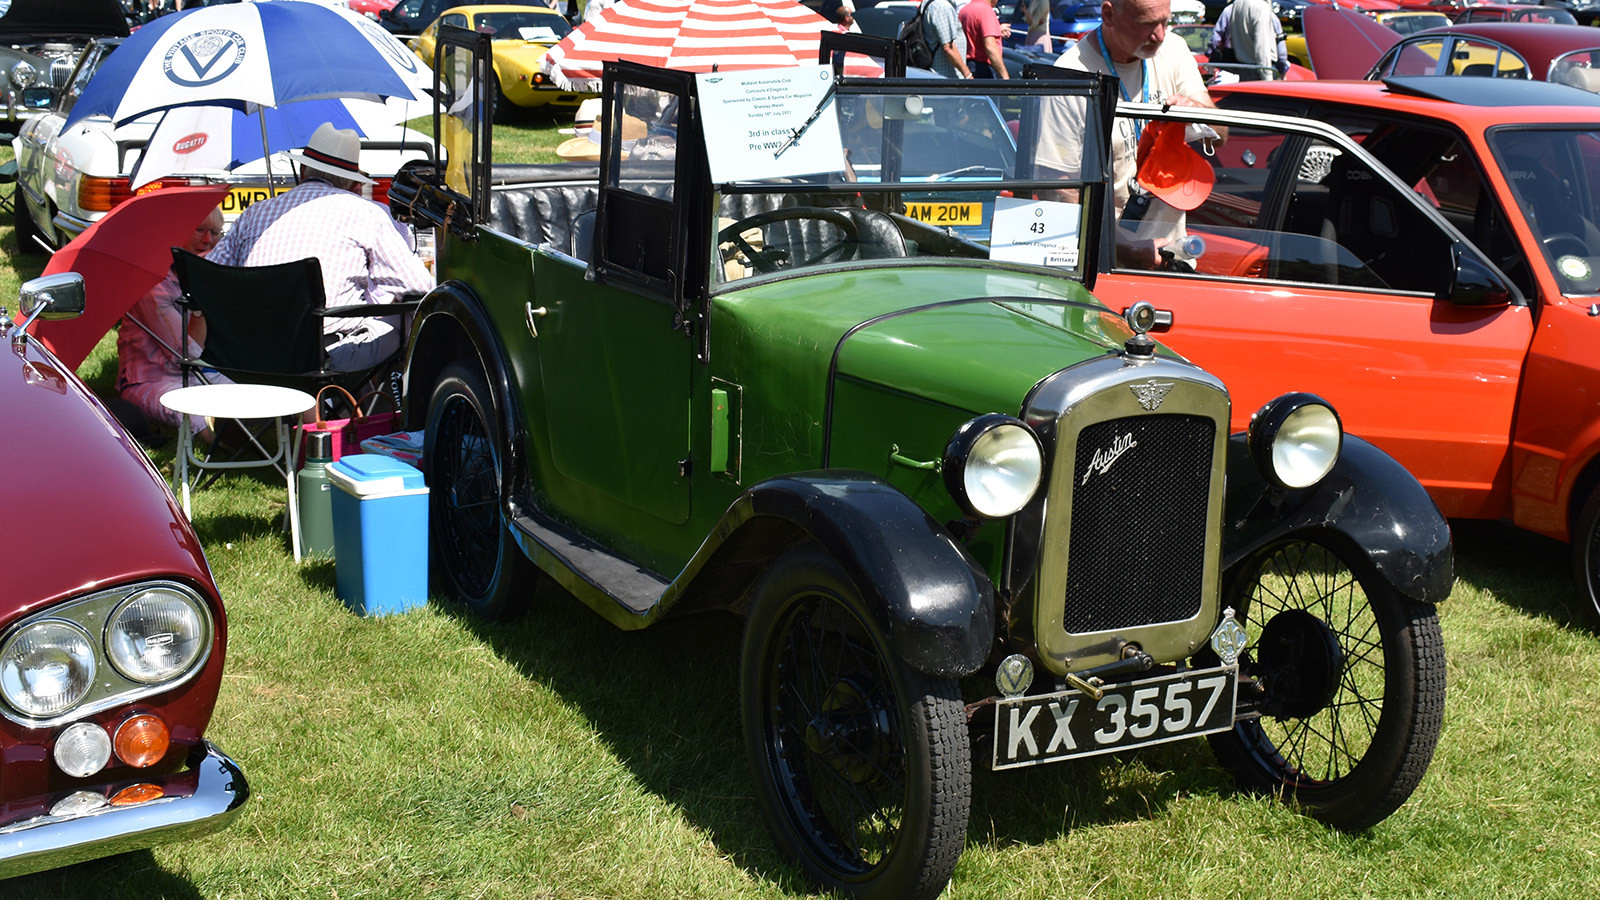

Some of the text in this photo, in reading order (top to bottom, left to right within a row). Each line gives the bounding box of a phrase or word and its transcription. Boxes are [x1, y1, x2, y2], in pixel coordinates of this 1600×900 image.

[163, 29, 246, 73] THE VINTAGE SPORTS CAR CLUB
[748, 130, 761, 138] 3rd
[771, 128, 791, 136] class
[175, 136, 205, 151] BUGATTI
[1346, 170, 1373, 180] COB
[937, 205, 970, 221] 20M
[1030, 222, 1045, 234] 43
[1082, 432, 1138, 486] Austin
[1007, 676, 1227, 759] KX 3557
